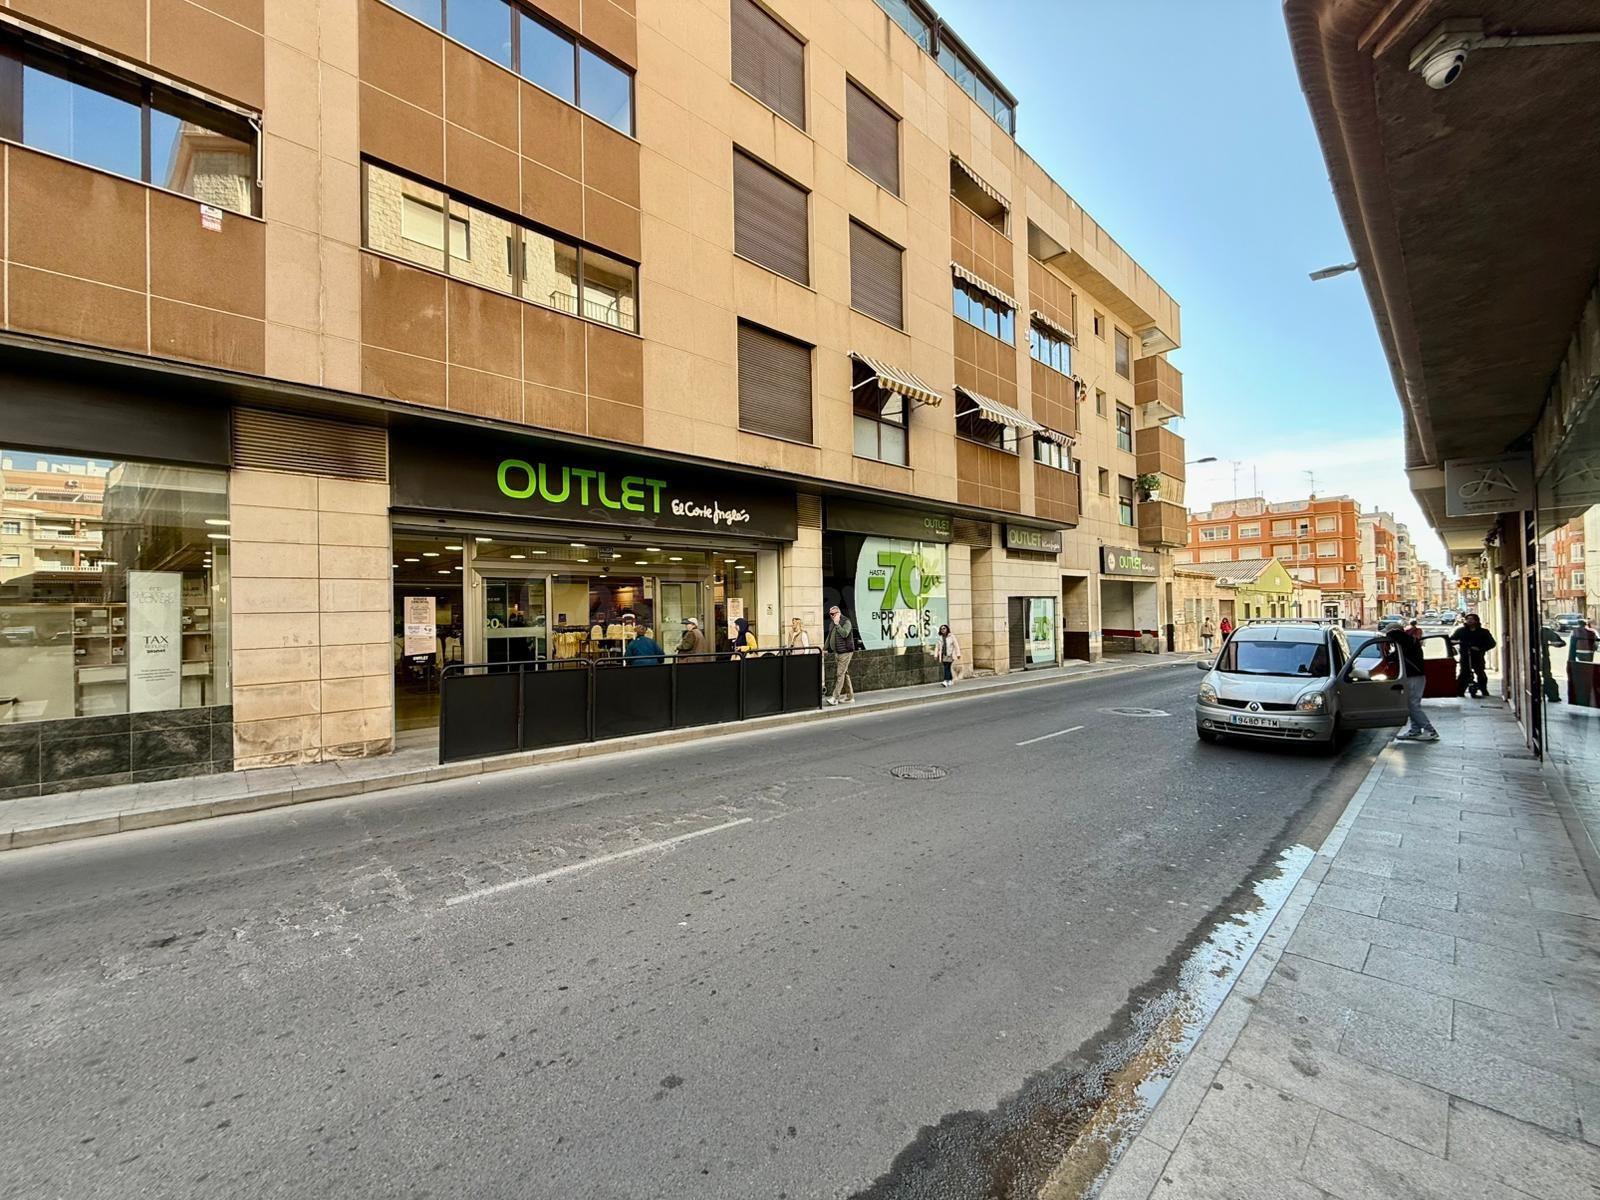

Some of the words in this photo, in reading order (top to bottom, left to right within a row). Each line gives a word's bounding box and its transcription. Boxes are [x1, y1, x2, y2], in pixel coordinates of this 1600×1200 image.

[497, 458, 667, 513] OUTLET
[671, 499, 685, 516] El
[685, 501, 713, 519] Corte
[713, 500, 750, 526] Inglés
[924, 517, 949, 530] OUTLET
[1009, 529, 1042, 547] OUTLET
[1119, 555, 1142, 570] OUTLET
[869, 569, 886, 577] HASTA
[144, 635, 169, 645] TAX
[881, 623, 931, 641] MCS
